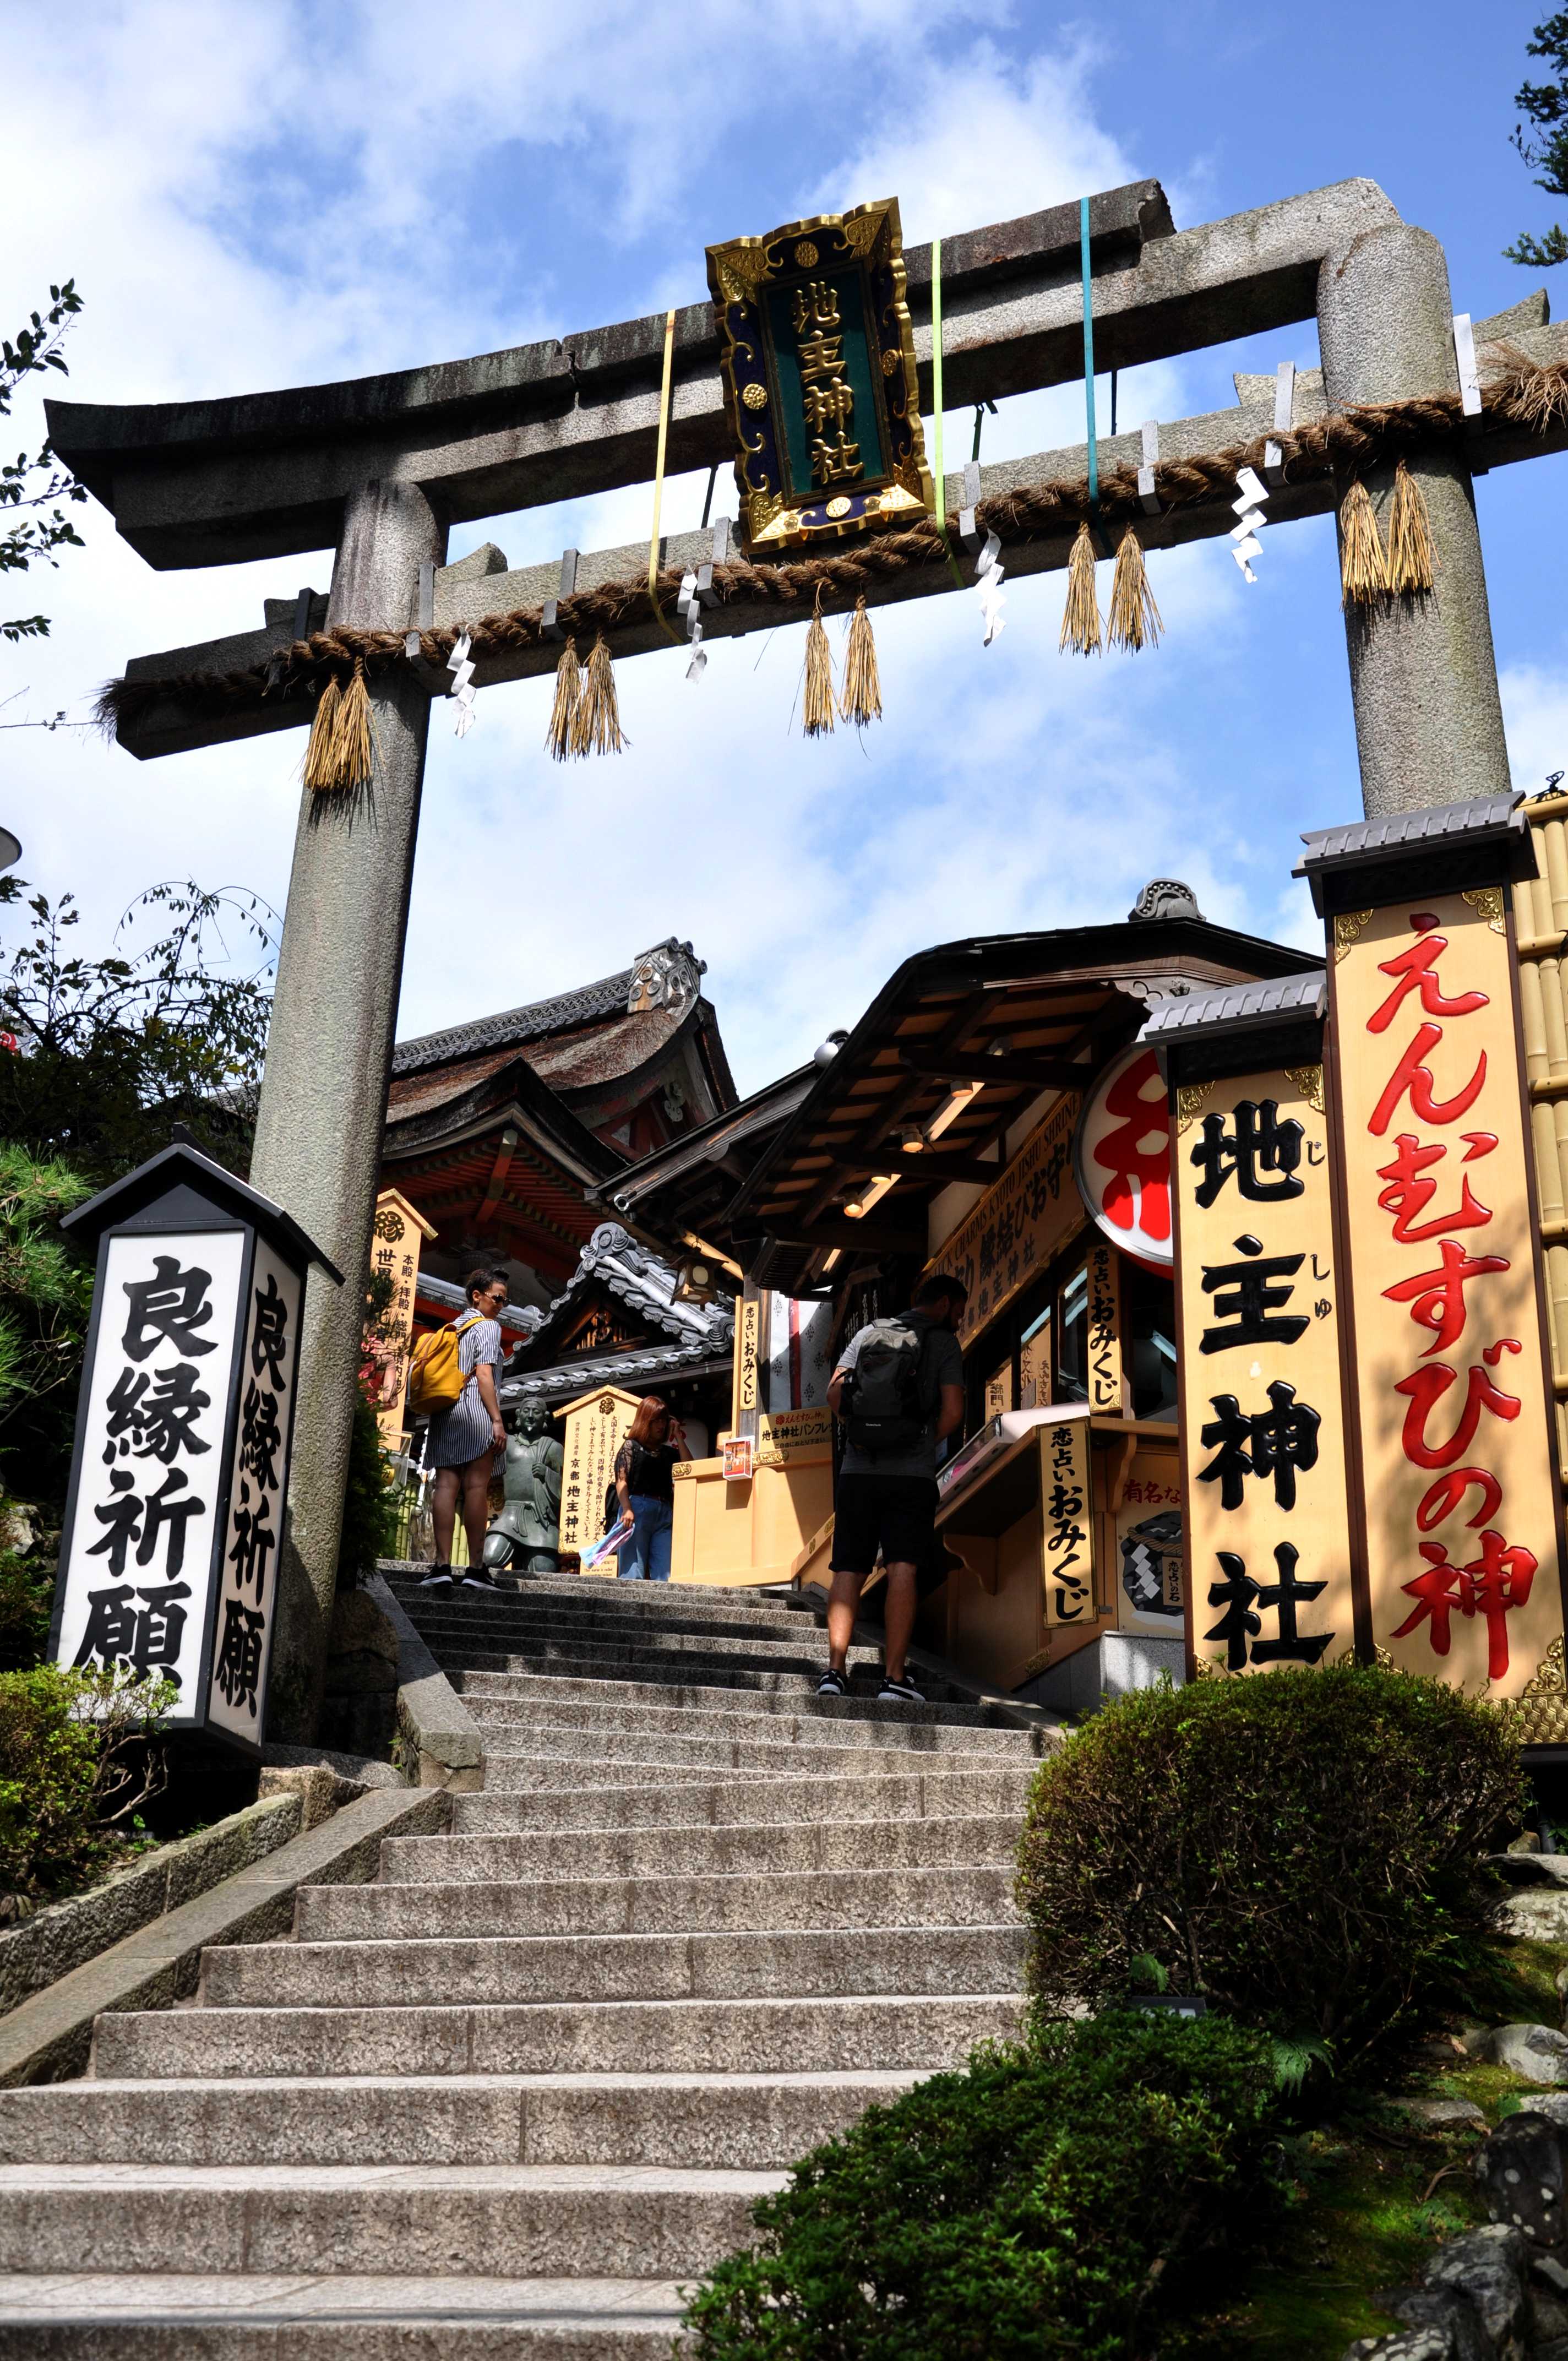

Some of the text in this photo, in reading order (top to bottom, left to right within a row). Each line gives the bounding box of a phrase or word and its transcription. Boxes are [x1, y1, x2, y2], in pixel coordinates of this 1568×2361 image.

[791, 280, 864, 485] 地主神社
[955, 1211, 987, 1260] CHARMS
[989, 1174, 1016, 1221] KYOTO
[1017, 1144, 1042, 1191] JISHU
[1043, 1096, 1078, 1152] SHRINE
[742, 1307, 756, 1405] 恋占いおみくじ
[1090, 1248, 1118, 1405] 恋占いおみくじ
[1189, 1099, 1336, 1673] 地主神社
[1366, 913, 1538, 1680] えんむすびの神
[73, 1255, 219, 1690] 良縁祈願
[214, 1272, 287, 1717] 良縁祈願
[1047, 1427, 1089, 1621] 恋占いおみくじ
[1167, 1560, 1181, 1603] 恋占いの石
